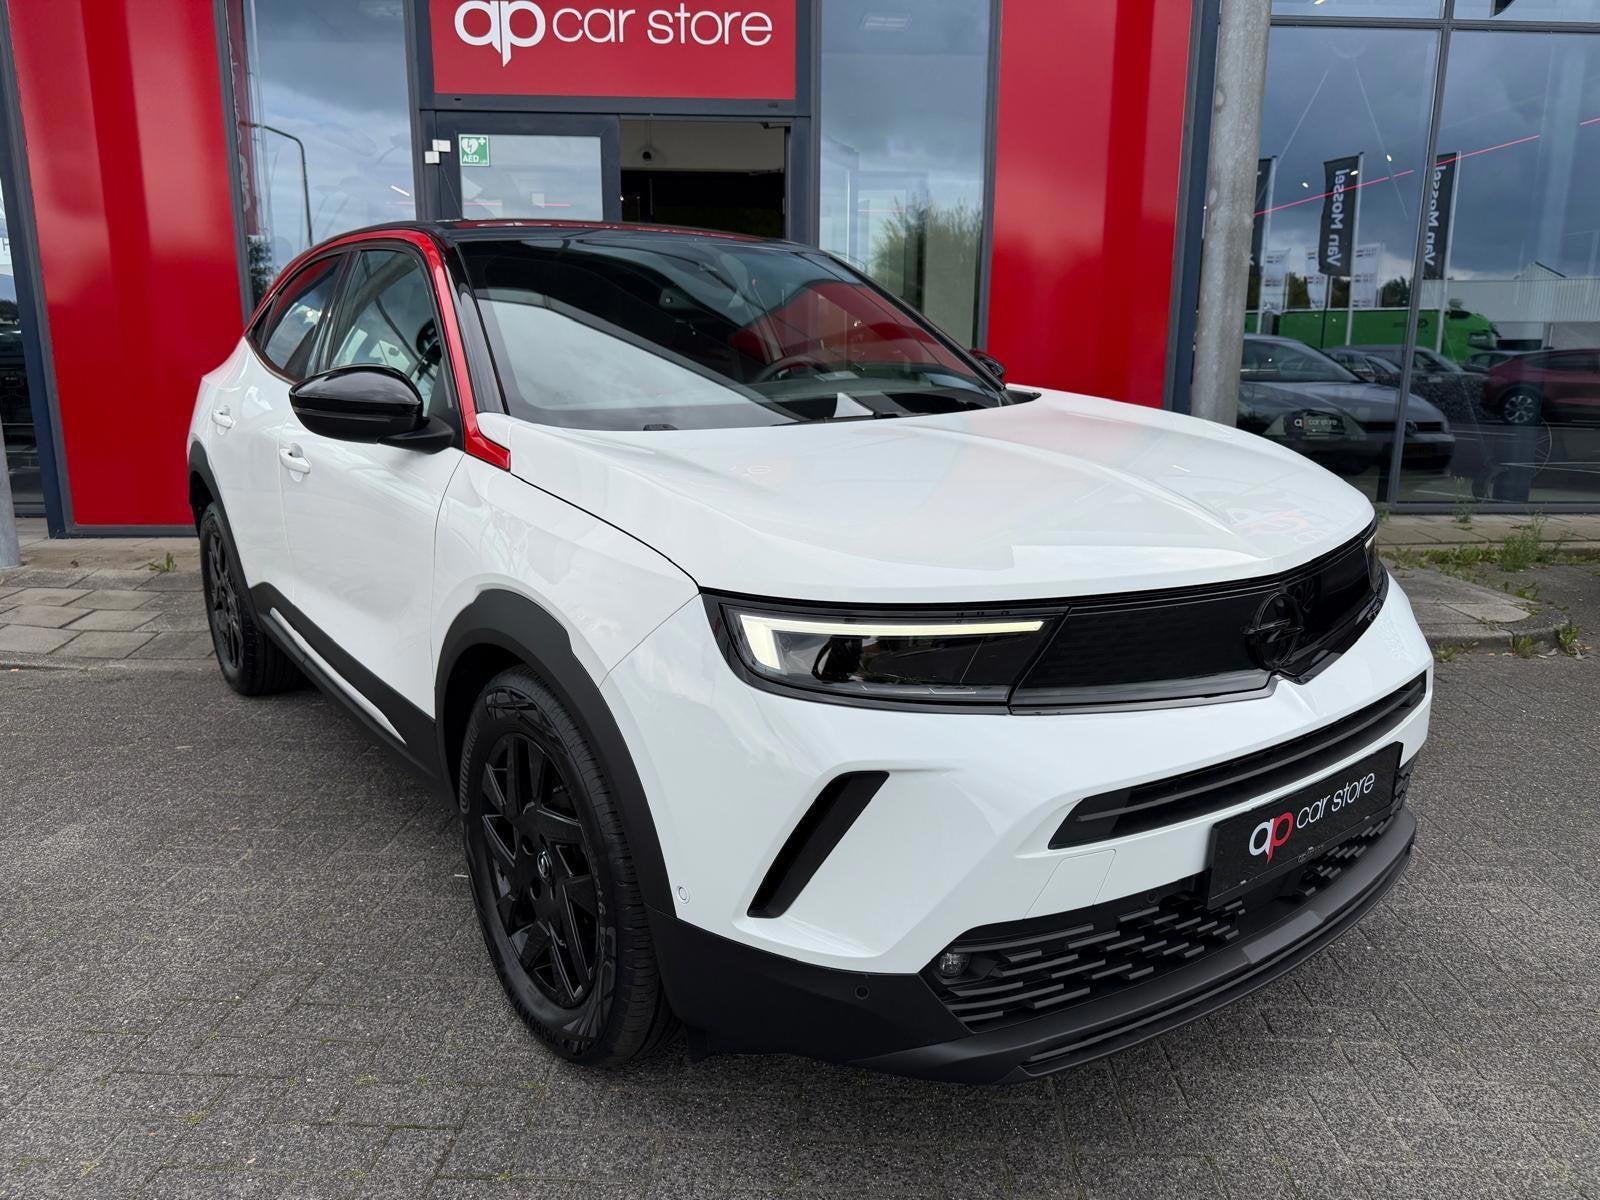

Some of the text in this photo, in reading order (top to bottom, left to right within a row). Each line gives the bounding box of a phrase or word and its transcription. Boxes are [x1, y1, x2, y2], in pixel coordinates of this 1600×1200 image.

[552, 7, 636, 43] car
[647, 2, 773, 46] store
[462, 154, 480, 163] AED
[1249, 812, 1294, 864] ap
[1296, 795, 1331, 828] car
[1331, 772, 1375, 812] store
